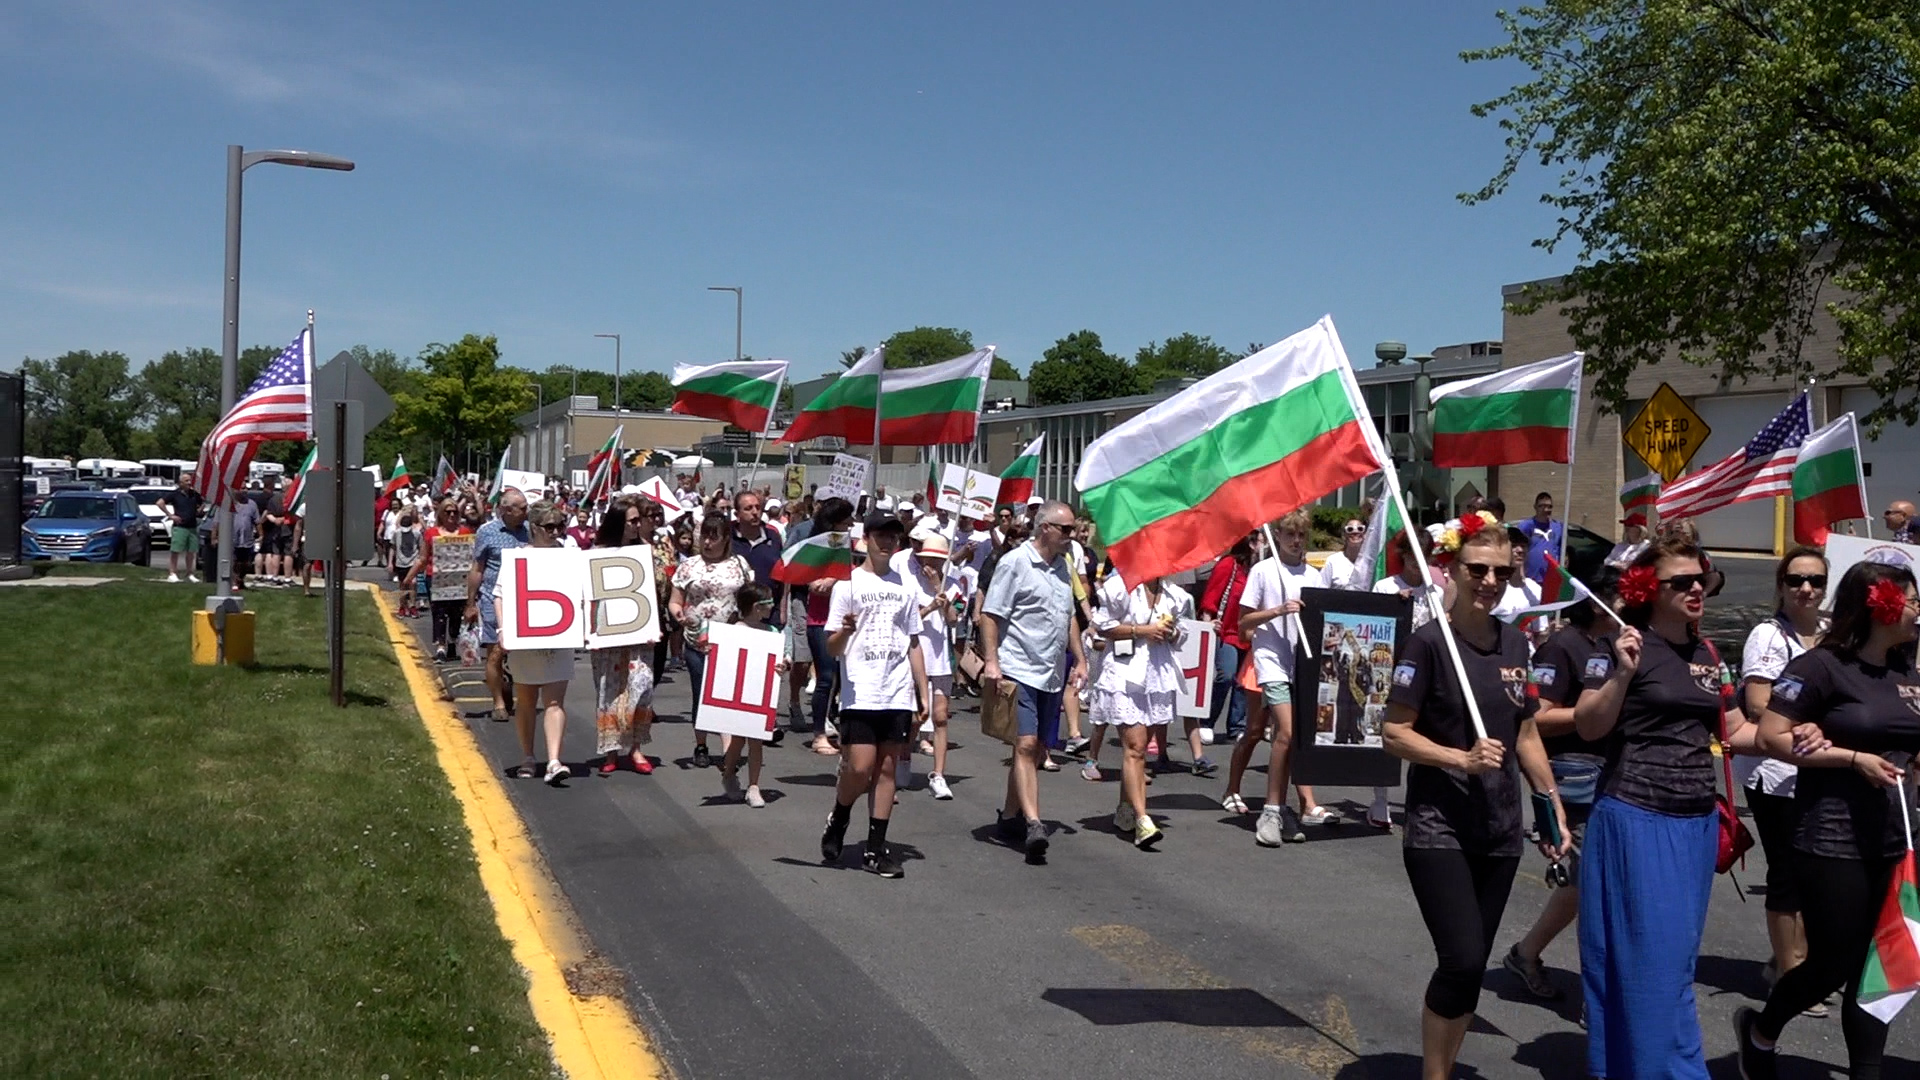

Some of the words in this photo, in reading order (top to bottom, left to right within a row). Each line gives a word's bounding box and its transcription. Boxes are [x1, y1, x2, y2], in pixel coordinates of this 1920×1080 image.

[1645, 418, 1690, 435] SPEED
[1647, 436, 1687, 453] HUMP
[514, 558, 575, 637] Ь
[861, 591, 903, 604] BULGARIA
[1356, 623, 1370, 645] 24
[702, 642, 777, 732] Щ
